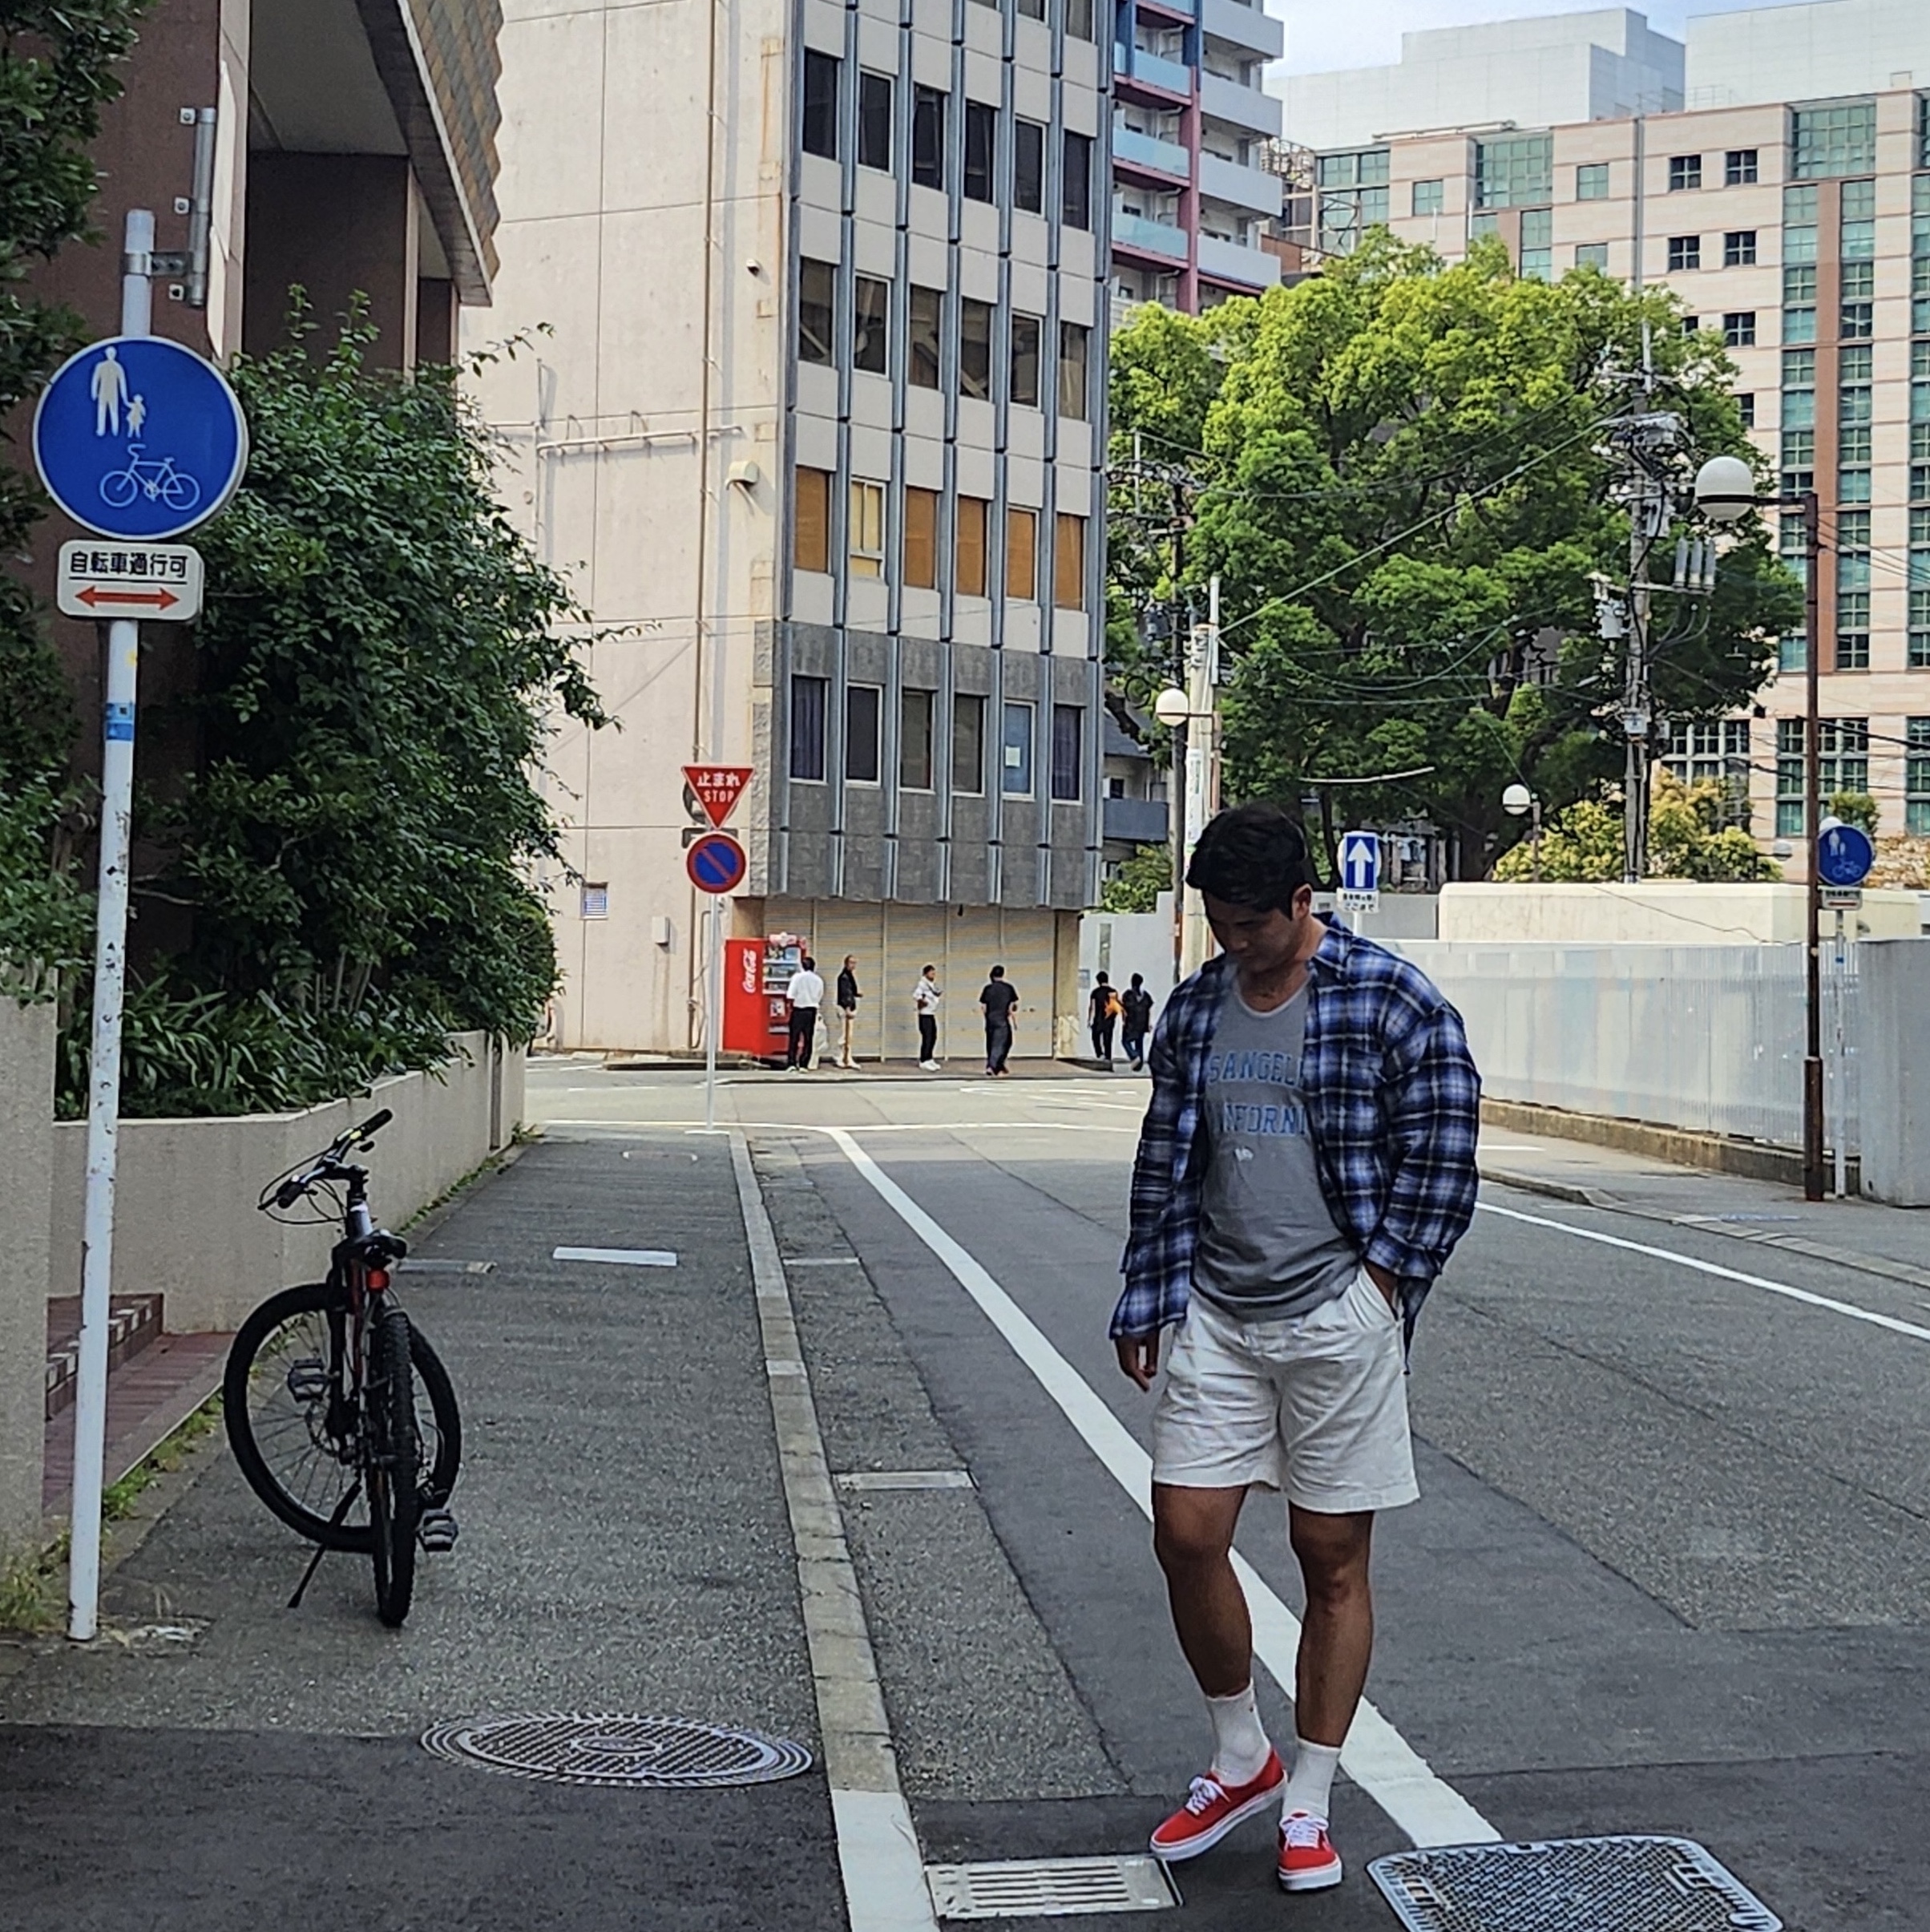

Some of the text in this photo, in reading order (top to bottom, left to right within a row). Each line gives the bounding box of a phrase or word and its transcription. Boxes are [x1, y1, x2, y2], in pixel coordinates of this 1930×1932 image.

[71, 551, 188, 578] 自転車通行可
[696, 771, 741, 787] 止まれ
[704, 790, 734, 802] STOP
